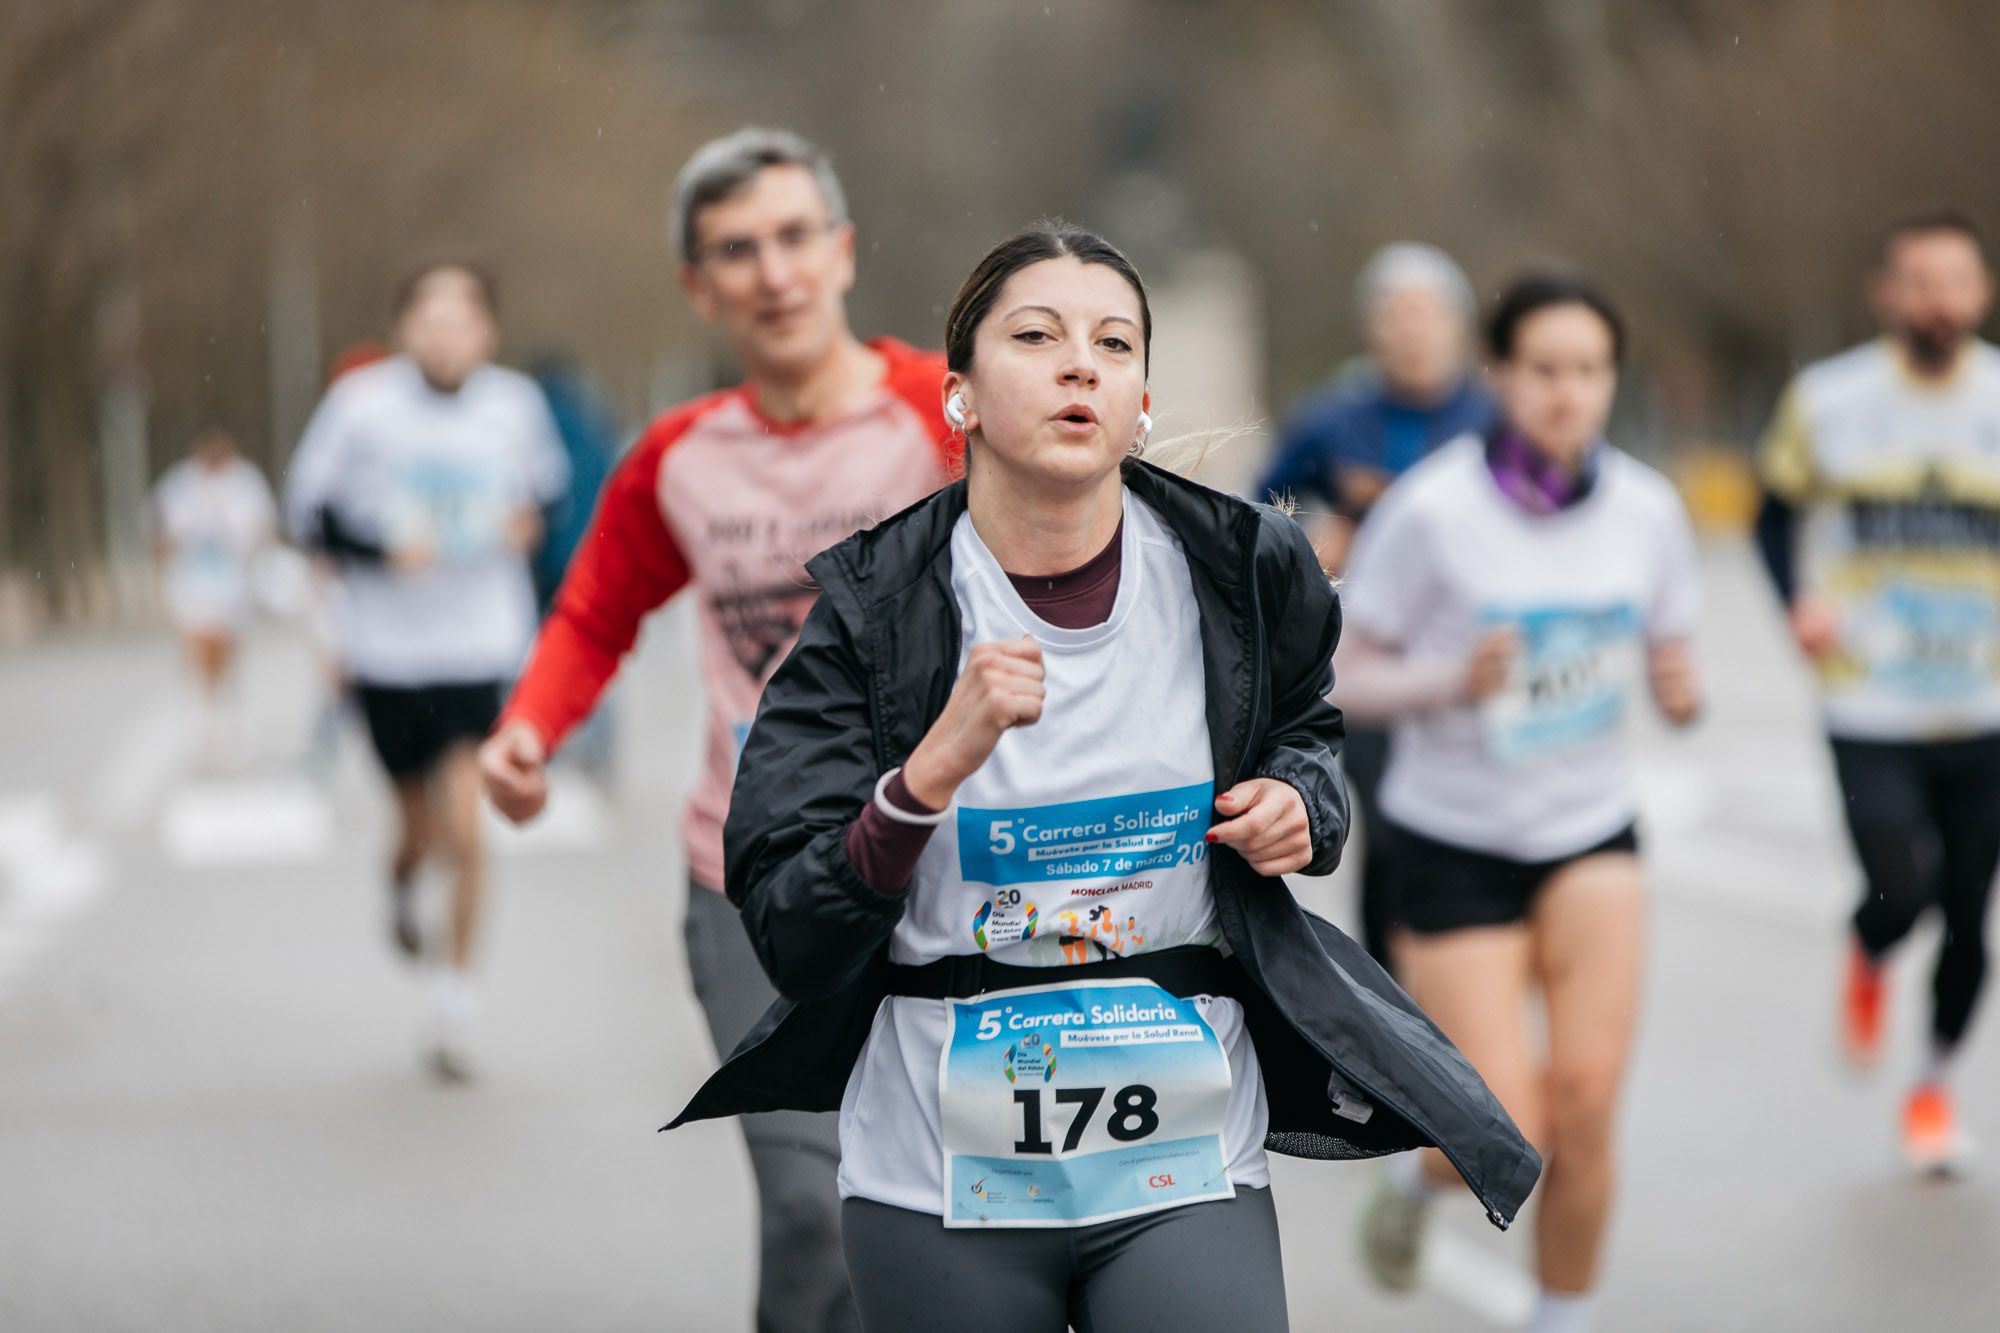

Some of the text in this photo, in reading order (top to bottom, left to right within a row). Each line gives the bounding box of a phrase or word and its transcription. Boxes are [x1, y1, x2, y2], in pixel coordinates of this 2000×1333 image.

[1023, 821, 1106, 843] Carrera
[1114, 806, 1199, 832] Solidaria
[1083, 844, 1099, 853] por
[1102, 841, 1112, 849] la
[1115, 838, 1144, 847] Salud
[1147, 835, 1173, 846] Renal
[1046, 859, 1098, 876] Sábado
[1102, 858, 1111, 872] 7
[1115, 857, 1132, 871] de
[1136, 852, 1173, 869] marzo
[1071, 881, 1153, 897] MONCLOA MADRID
[1008, 1010, 1085, 1030] Carrera
[1091, 1003, 1176, 1025] Solidaria
[1068, 1028, 1199, 1043] Muévete por la Salud Renal
[1013, 1084, 1159, 1155] 178
[1148, 1173, 1176, 1188] CSL
